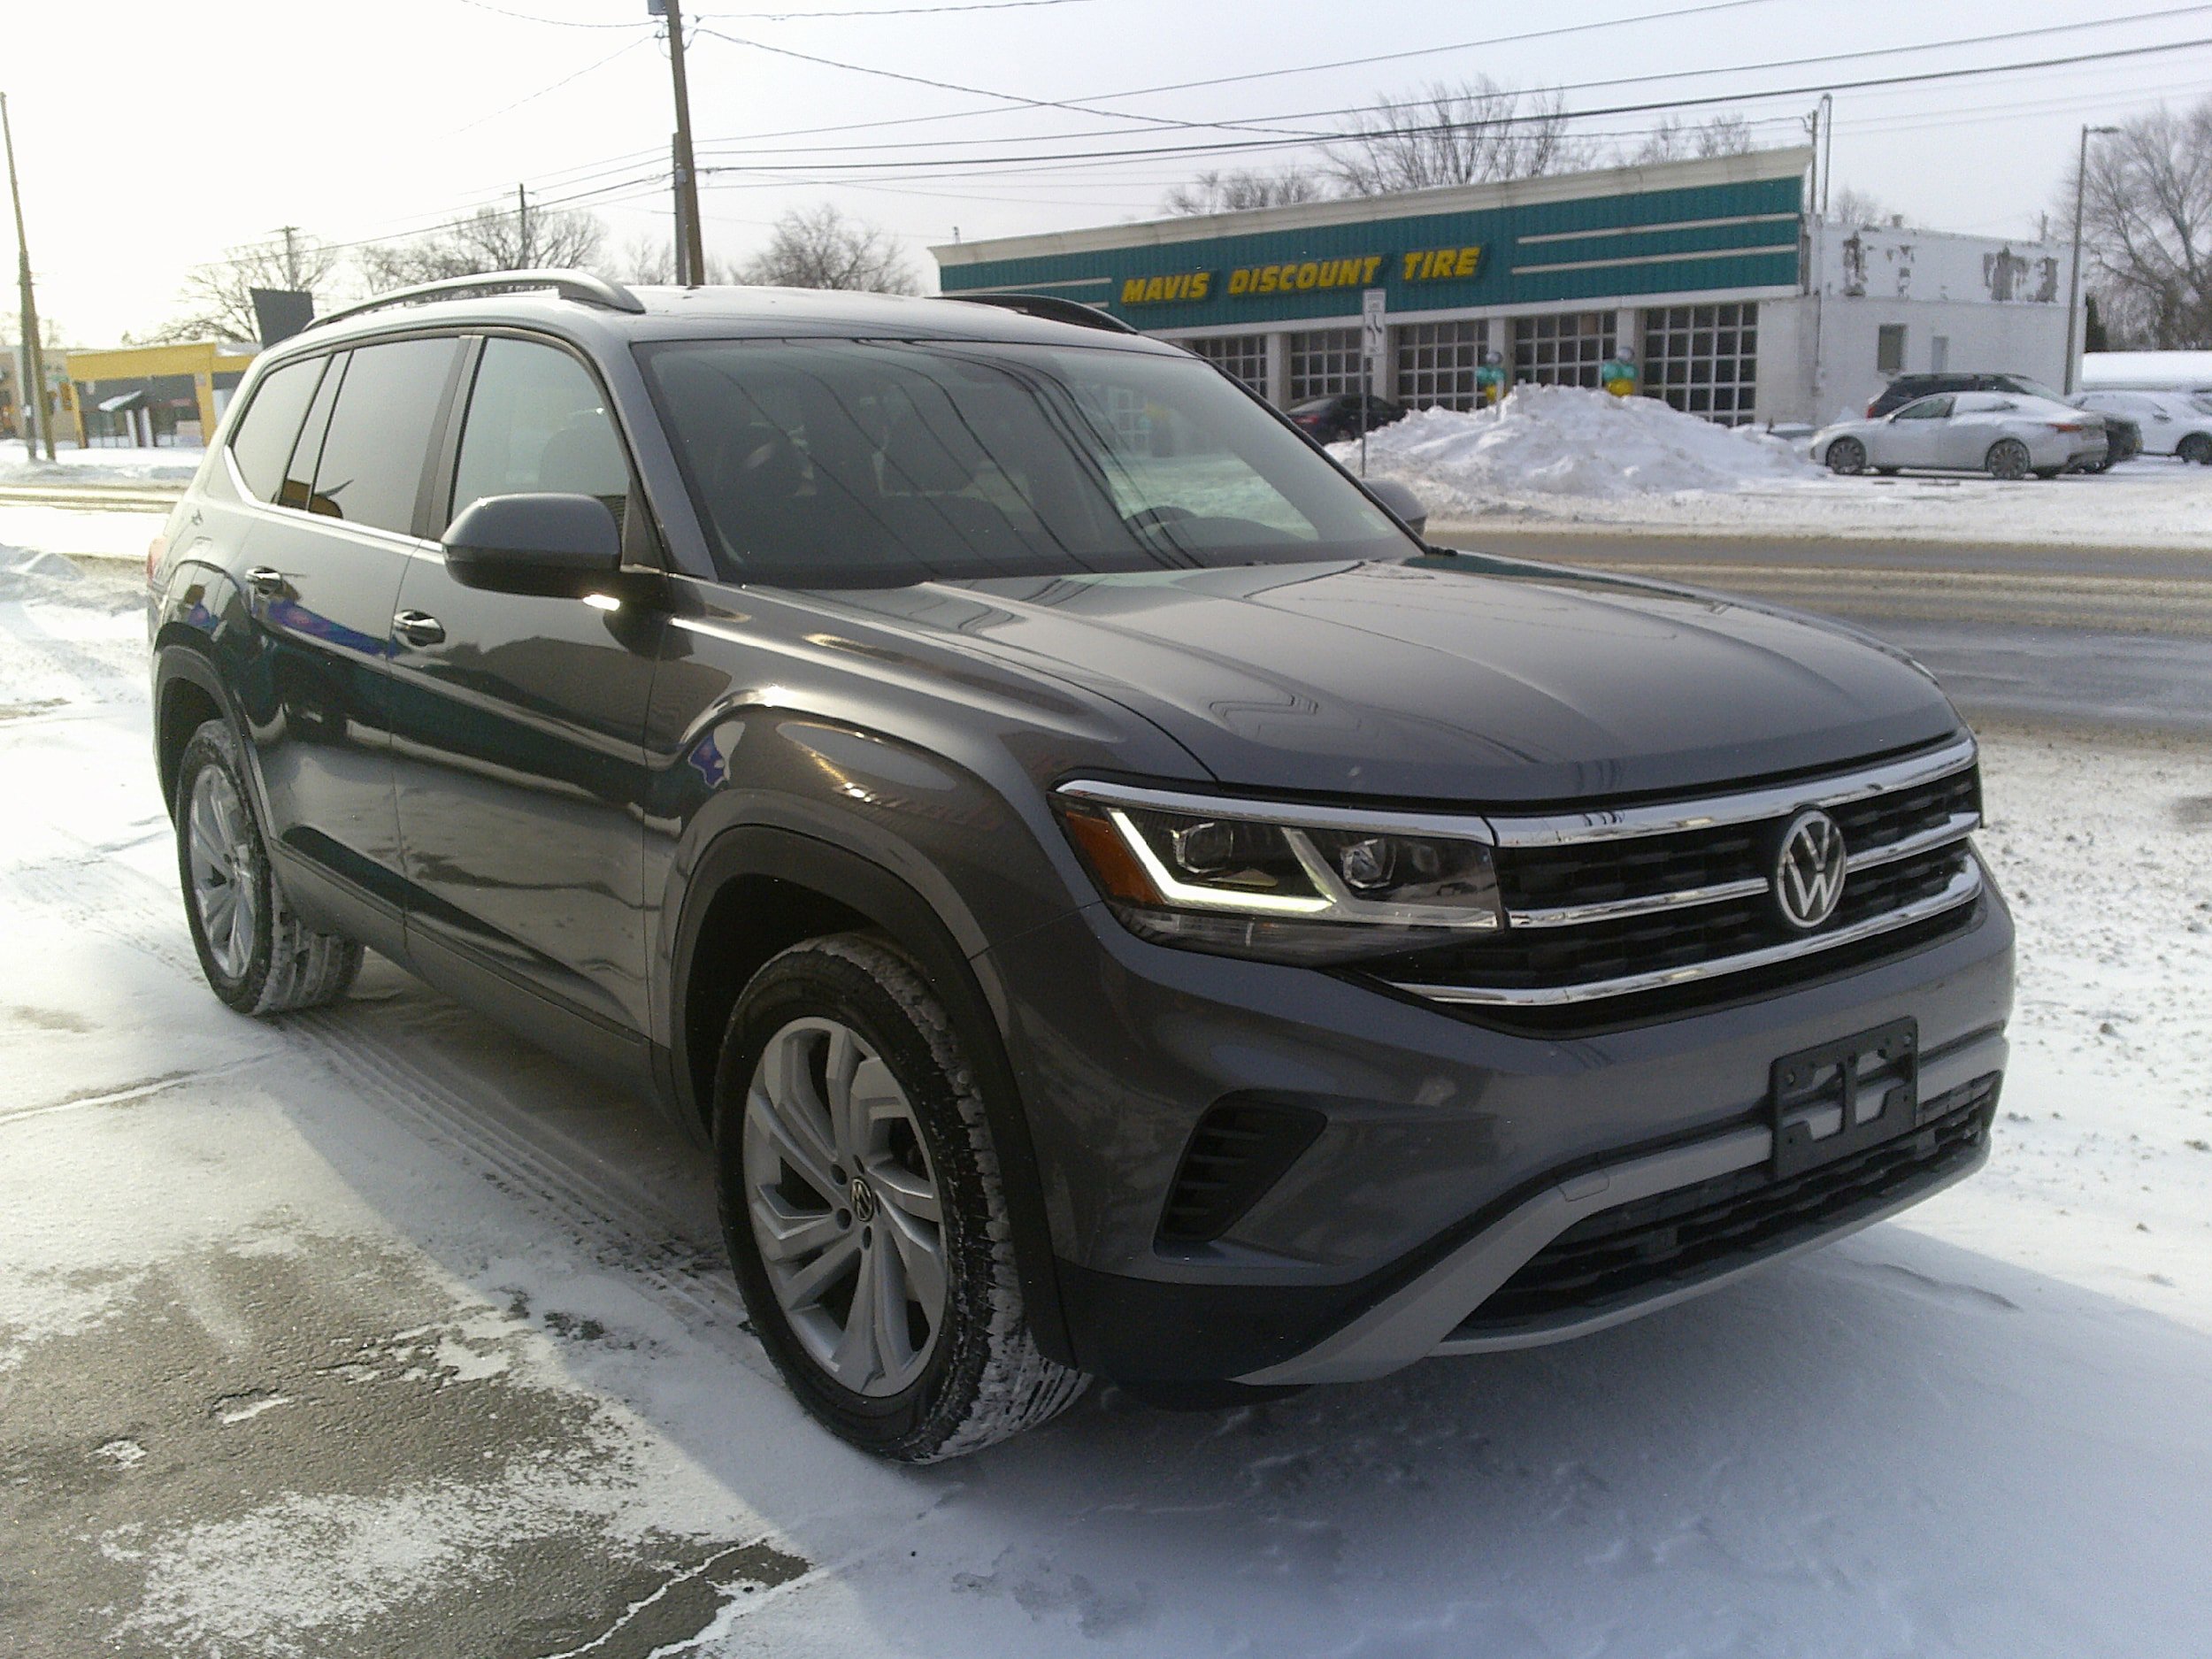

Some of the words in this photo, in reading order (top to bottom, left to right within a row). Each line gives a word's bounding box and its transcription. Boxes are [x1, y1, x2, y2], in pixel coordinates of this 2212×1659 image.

[1120, 271, 1211, 305] MAVIS
[1227, 255, 1382, 296] DISCOUNT
[1402, 246, 1481, 281] TIRE
